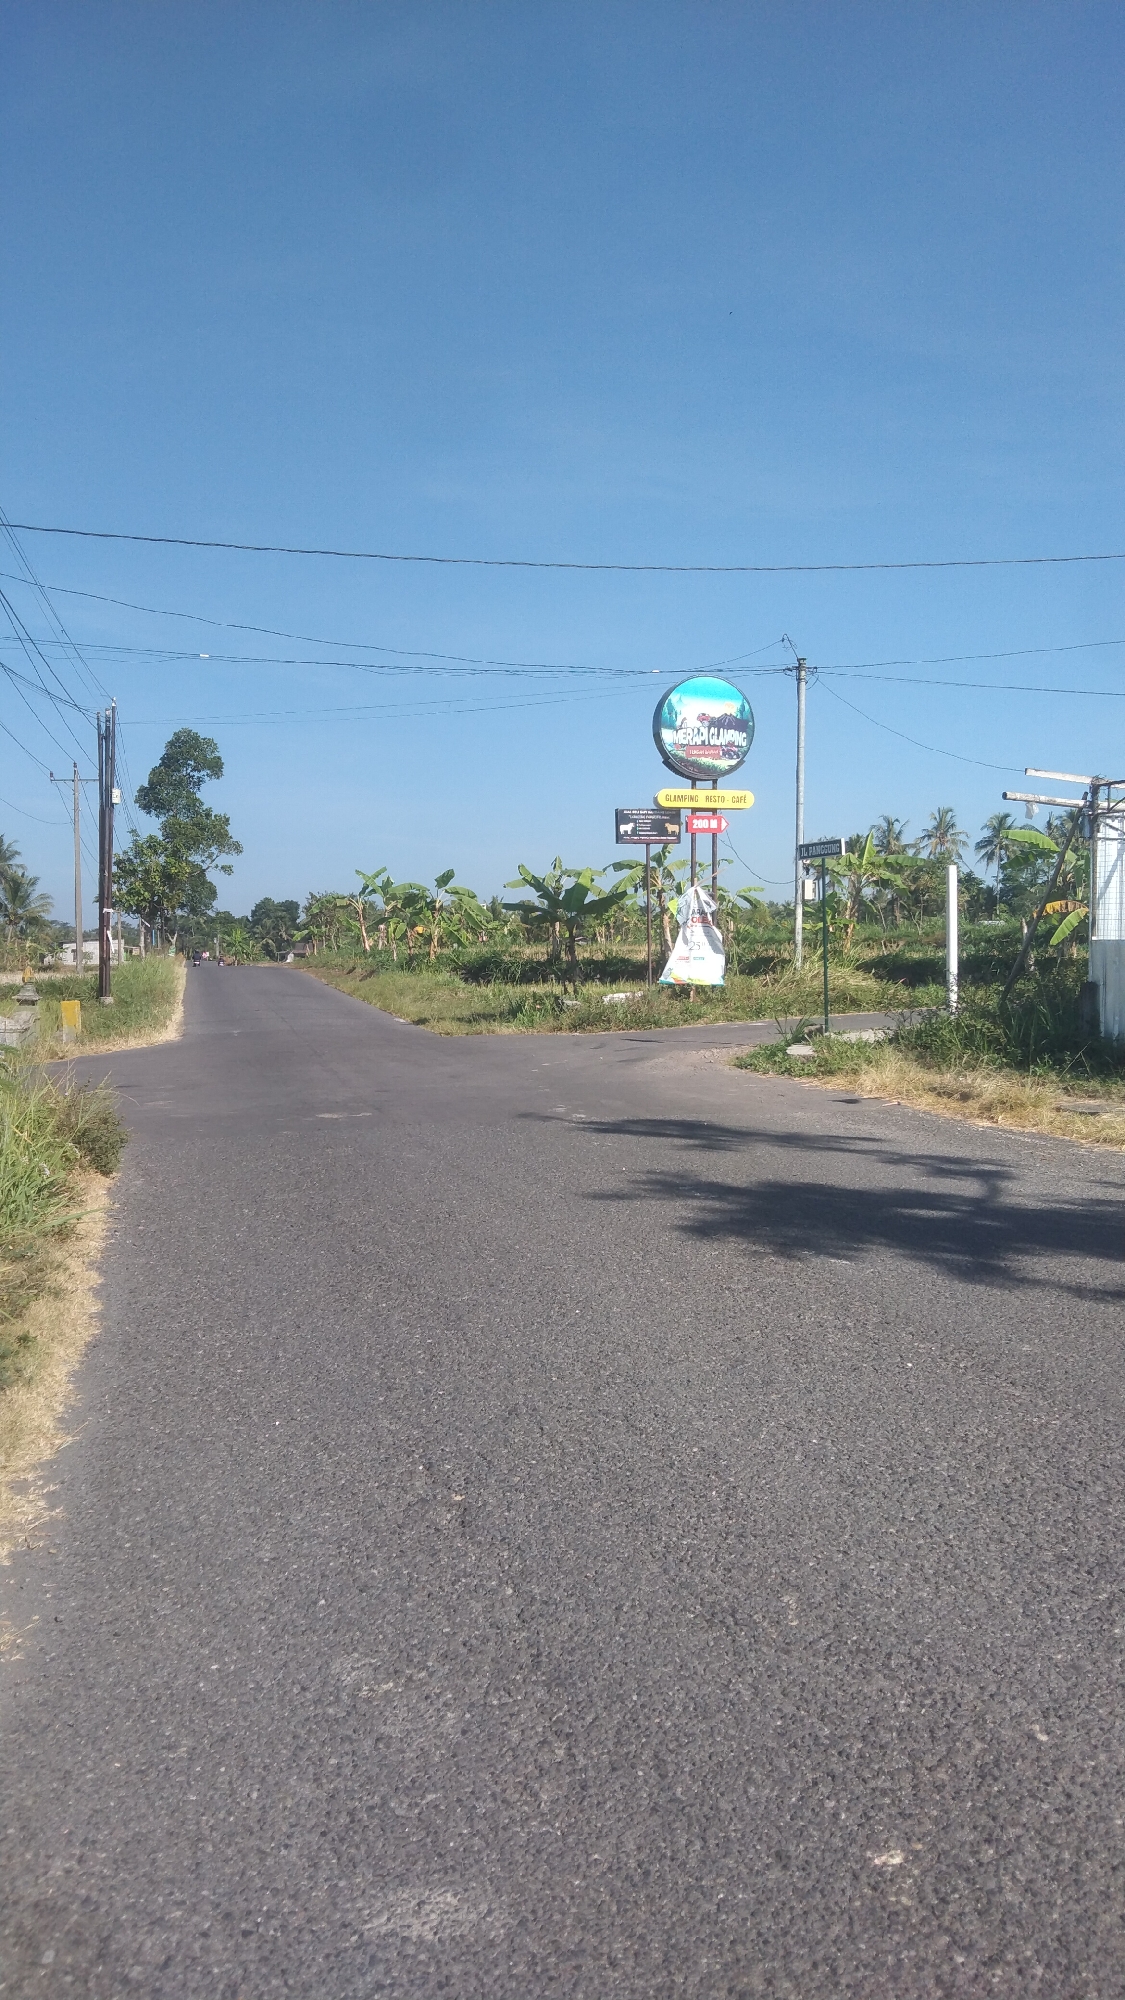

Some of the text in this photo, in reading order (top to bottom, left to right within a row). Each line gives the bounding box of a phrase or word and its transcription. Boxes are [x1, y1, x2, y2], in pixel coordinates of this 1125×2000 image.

[673, 726, 747, 747] MERAPI GLAMPING
[665, 793, 699, 803] GLAMPING
[705, 795, 726, 804] RESTO
[731, 793, 747, 804] CAFÉ
[692, 818, 718, 829] 200 M
[808, 842, 840, 857] PANGGUNG
